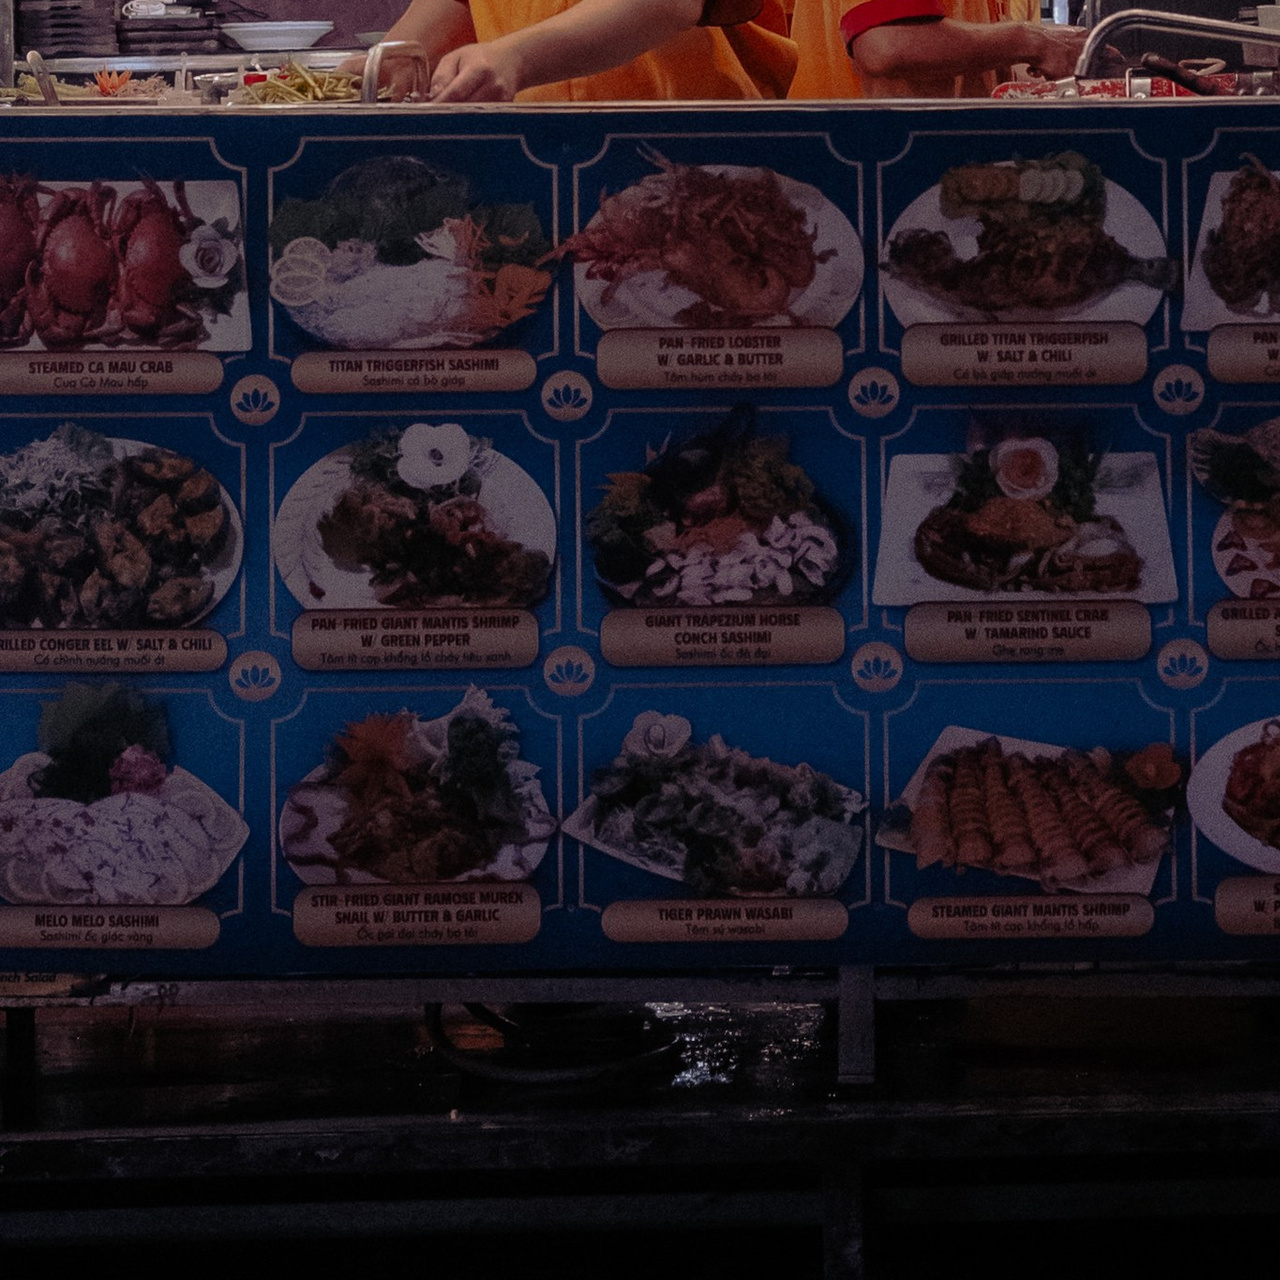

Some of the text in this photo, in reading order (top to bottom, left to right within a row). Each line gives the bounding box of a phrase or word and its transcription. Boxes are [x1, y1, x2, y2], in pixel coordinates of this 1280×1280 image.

[729, 336, 781, 348] LOBSTER
[940, 333, 1108, 345] GRILLED TITAN TRIGGERFISH
[677, 354, 720, 365] GARLIC
[725, 354, 733, 365] &
[738, 354, 783, 365] BUTTER
[997, 351, 1024, 361] SALT
[1029, 350, 1037, 361] &
[1041, 350, 1072, 361] CHILI
[29, 361, 173, 373] STEAMED CA MAU CRAB
[329, 359, 499, 372] TITAN TRIGGERFISH SASHIMI
[1017, 610, 1071, 621] SENTINEL
[1076, 609, 1109, 621] CRAB
[1222, 608, 1270, 619] GRILLED
[381, 617, 417, 629] GIANT
[422, 617, 468, 628] MANTIS
[472, 617, 519, 628] SHRIMP
[645, 614, 800, 627] GIANT TRAPEZIUM HORSE
[675, 632, 771, 644] CONCH SASHIMI
[986, 628, 1048, 639] TAMARIND
[1052, 627, 1091, 639] SAUCE
[40, 639, 89, 650] CONGER
[94, 639, 113, 650] EEL
[137, 639, 164, 650] SALT
[168, 639, 177, 650] &
[182, 639, 212, 650] CHILI
[381, 635, 420, 646] GREEN
[425, 634, 470, 646] PEPPER
[383, 894, 419, 905] GIANT
[424, 893, 475, 905] RAMOSE
[480, 893, 523, 904] MUREX
[336, 912, 368, 923] SNAIL
[393, 911, 438, 922] BUTTER
[443, 911, 451, 922] &
[456, 910, 499, 922] GARLIC
[658, 908, 792, 920] TIGER PRAWN WASABI
[932, 904, 1130, 917] STEAMED GIANT MANTIS SHRIMP
[35, 915, 159, 927] MELO MELO SASHIMI
